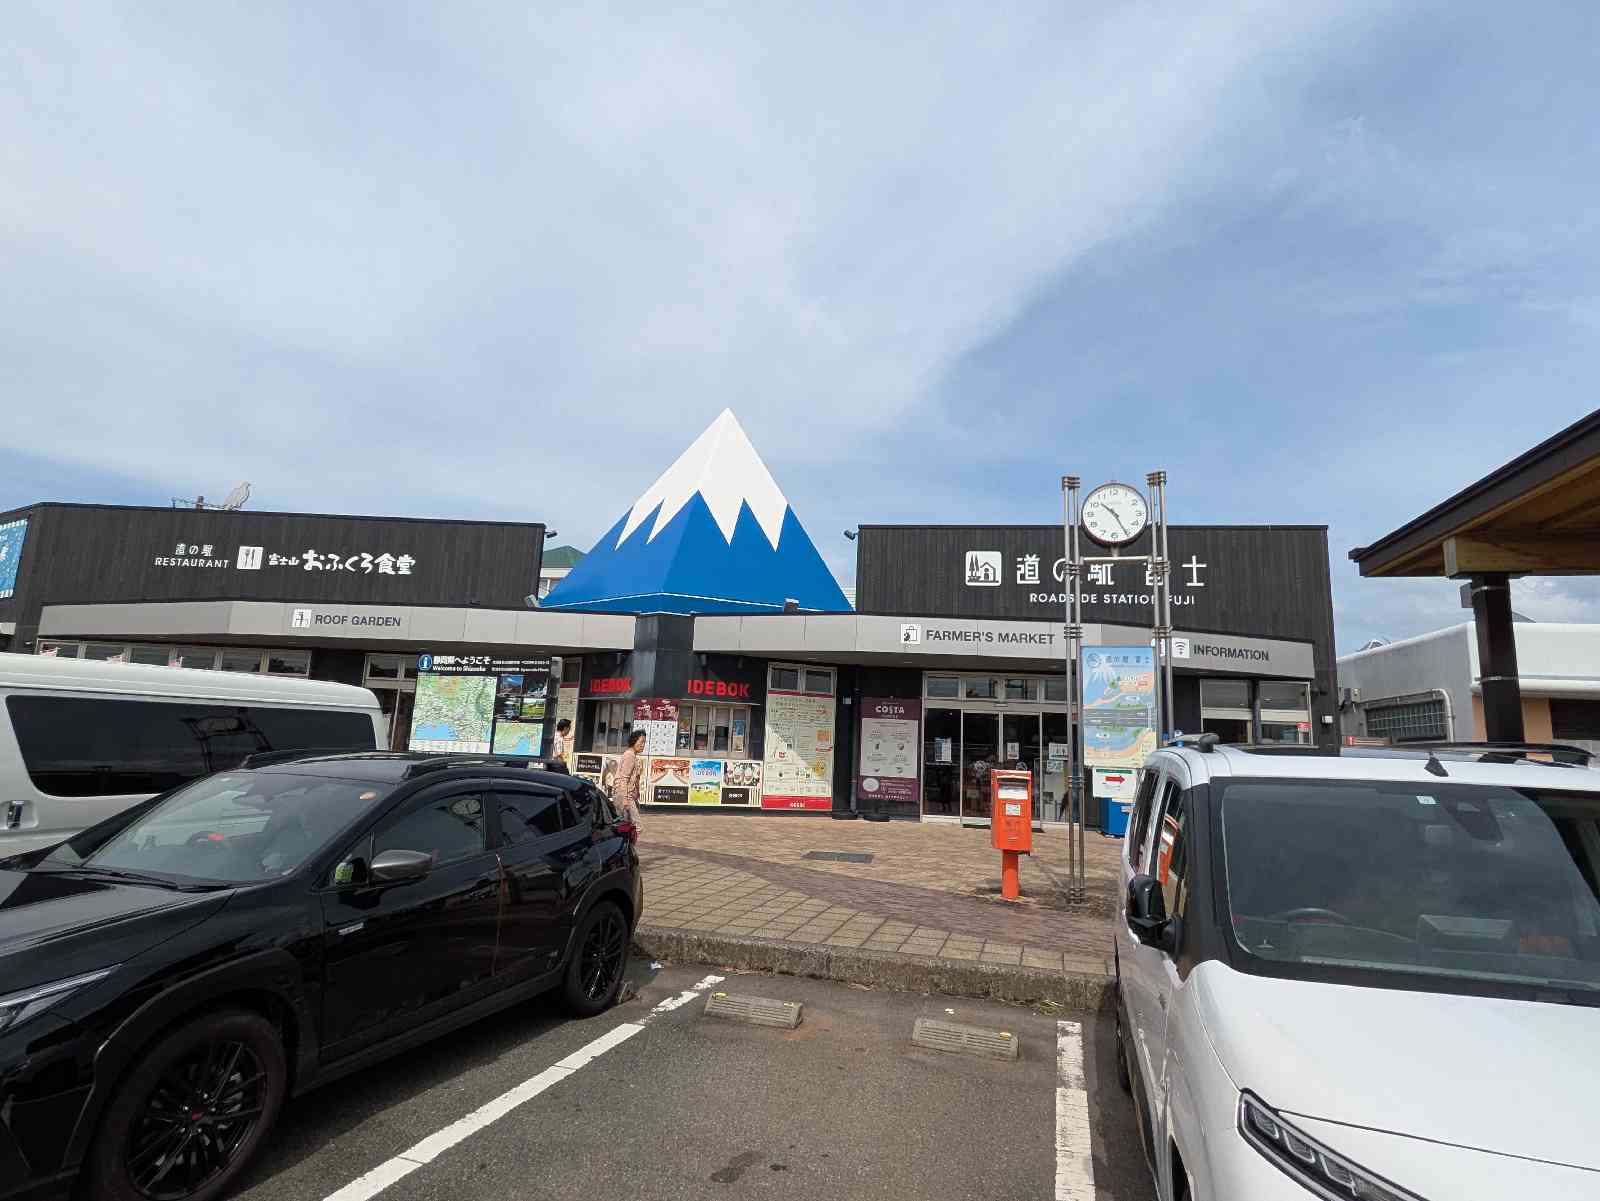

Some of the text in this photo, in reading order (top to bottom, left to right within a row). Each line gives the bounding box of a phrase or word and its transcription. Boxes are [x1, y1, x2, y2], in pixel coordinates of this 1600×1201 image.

[154, 557, 229, 568] RESTAURANT
[1029, 592, 1097, 603] ROADSDE
[315, 614, 401, 626] ROOF GARDEN
[926, 629, 1055, 644] FARMER'S MARKET
[1193, 644, 1270, 661] INFORMATION
[687, 679, 750, 697] IDEBOK
[875, 705, 905, 714] COSTA
